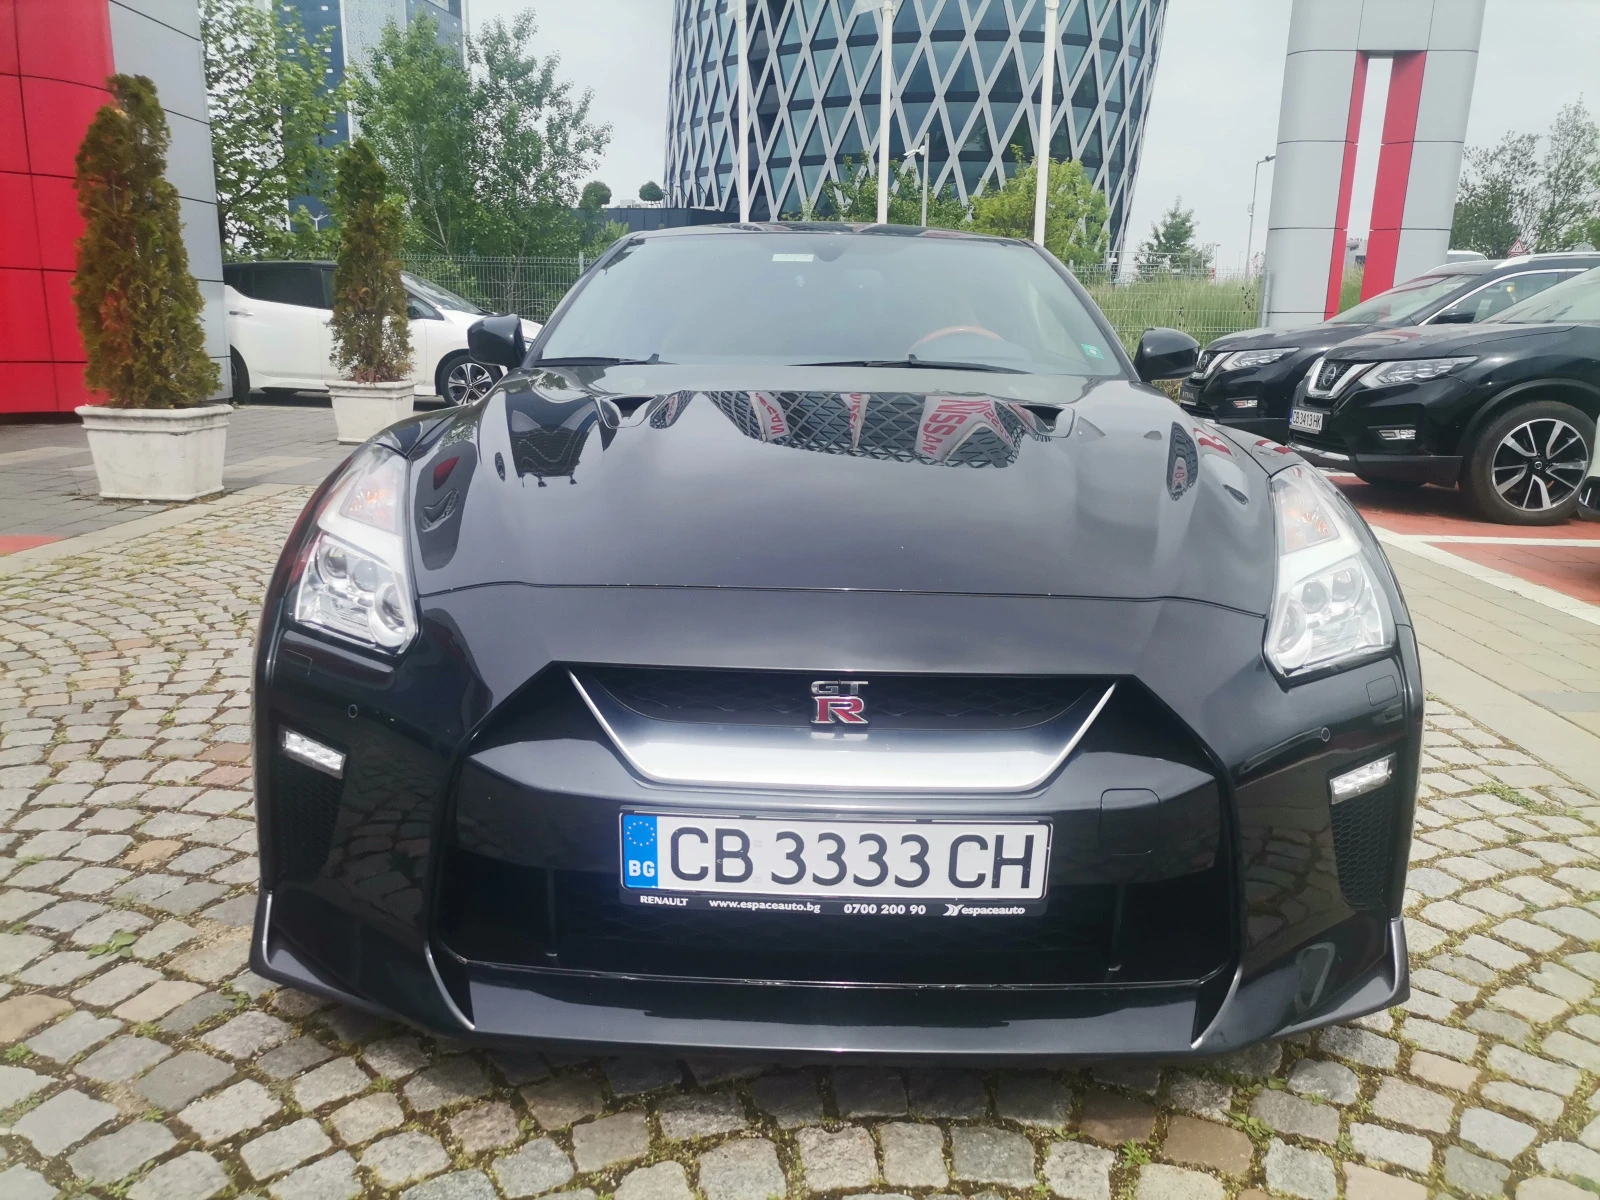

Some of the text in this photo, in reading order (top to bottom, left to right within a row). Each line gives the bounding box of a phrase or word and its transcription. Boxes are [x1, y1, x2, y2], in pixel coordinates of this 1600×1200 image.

[810, 680, 869, 695] GT
[810, 695, 869, 724] R
[628, 860, 656, 878] BG
[670, 826, 1035, 890] CB 3333 CH
[639, 895, 1026, 917] RENAULT www.espaceauto.bg 0700 200 90 espaceauto
